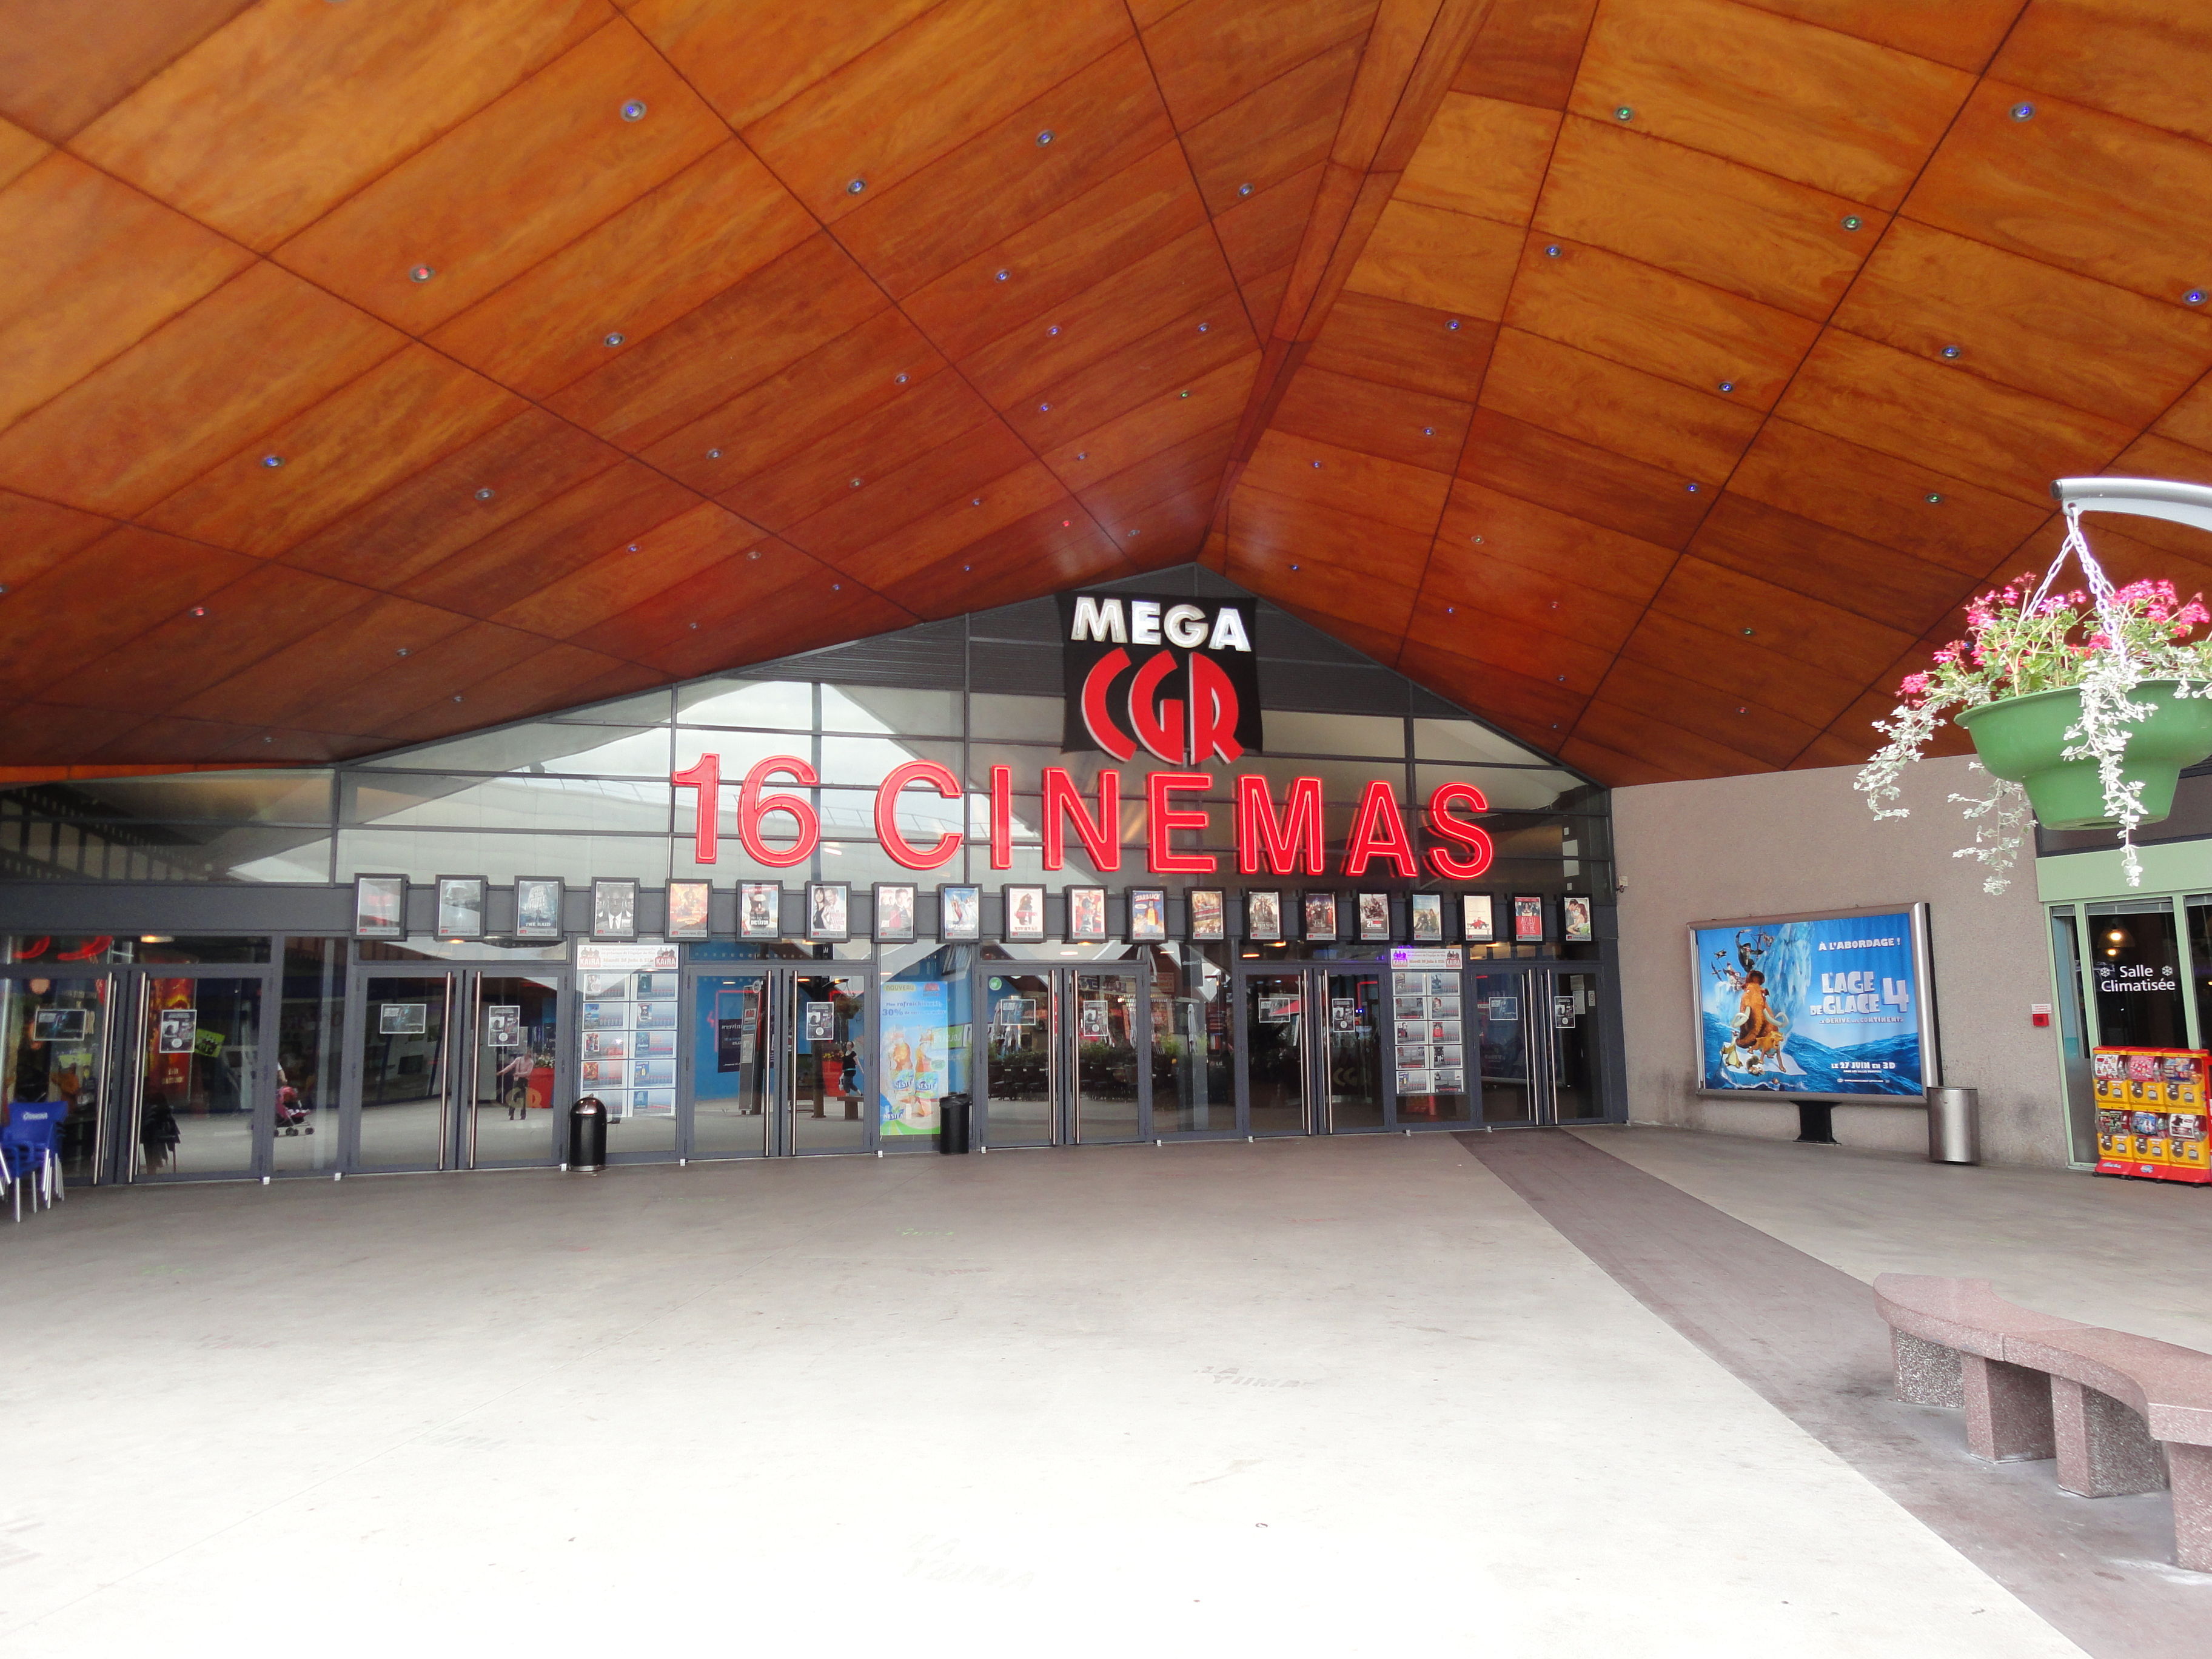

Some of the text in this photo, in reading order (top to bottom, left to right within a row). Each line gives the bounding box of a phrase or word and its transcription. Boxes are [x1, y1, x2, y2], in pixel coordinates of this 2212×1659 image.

[1071, 597, 1252, 652] MEGA
[1081, 646, 1245, 765] CGR
[671, 752, 1494, 880] 16 CINEMAS
[1818, 941, 1827, 951] À
[1829, 938, 1895, 950] L'ABORDAGE
[2101, 977, 2176, 992] Climatisée
[2119, 964, 2154, 977] Salle
[1809, 993, 1881, 1016] DE GLACE
[1882, 977, 1909, 1013] 4
